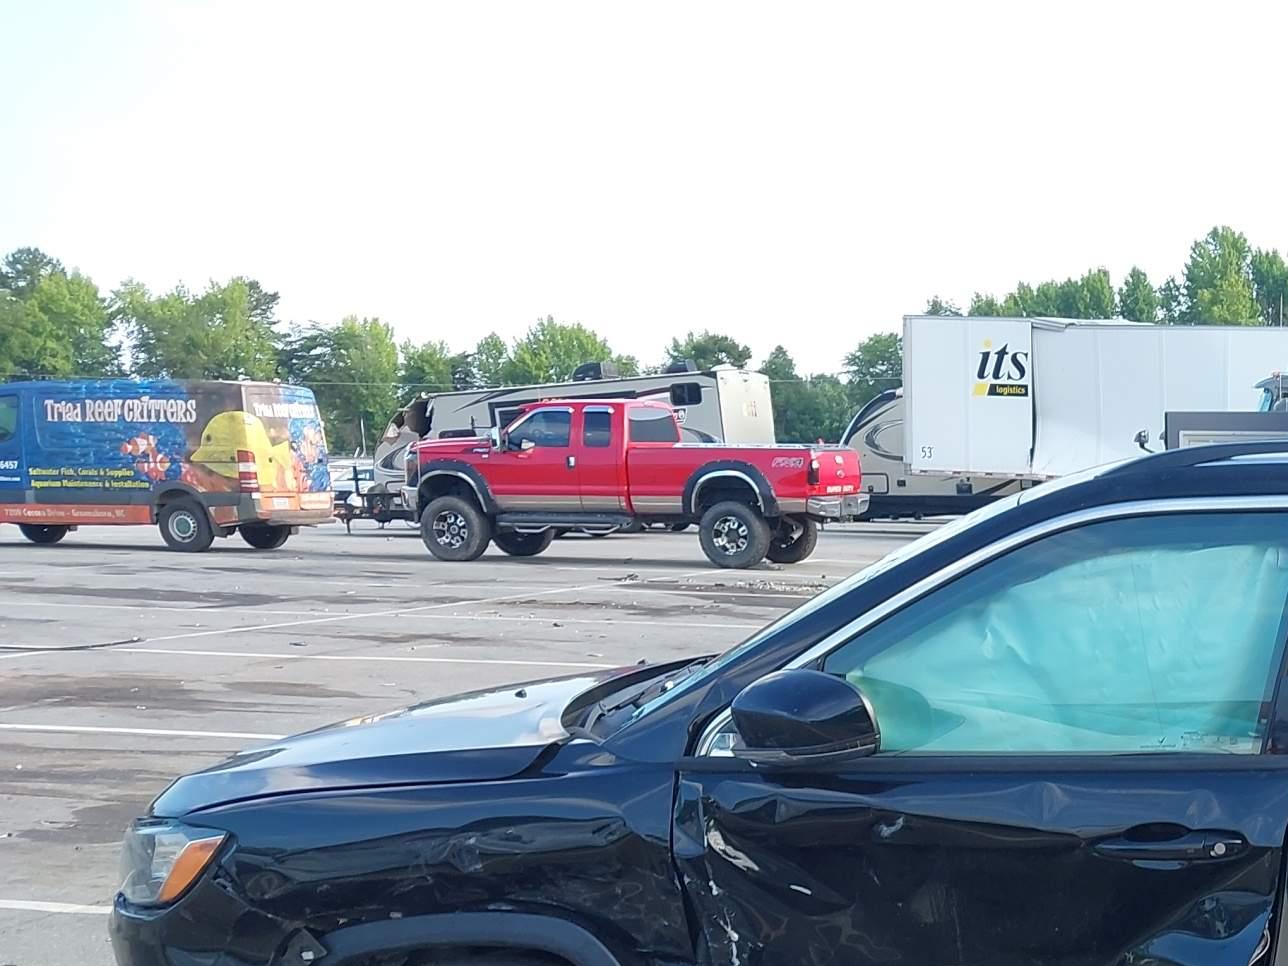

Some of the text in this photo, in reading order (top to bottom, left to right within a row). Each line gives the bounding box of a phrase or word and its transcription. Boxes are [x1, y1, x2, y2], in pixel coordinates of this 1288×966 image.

[977, 339, 1029, 381] its
[996, 385, 1026, 396] logistics
[44, 399, 82, 422] Triad
